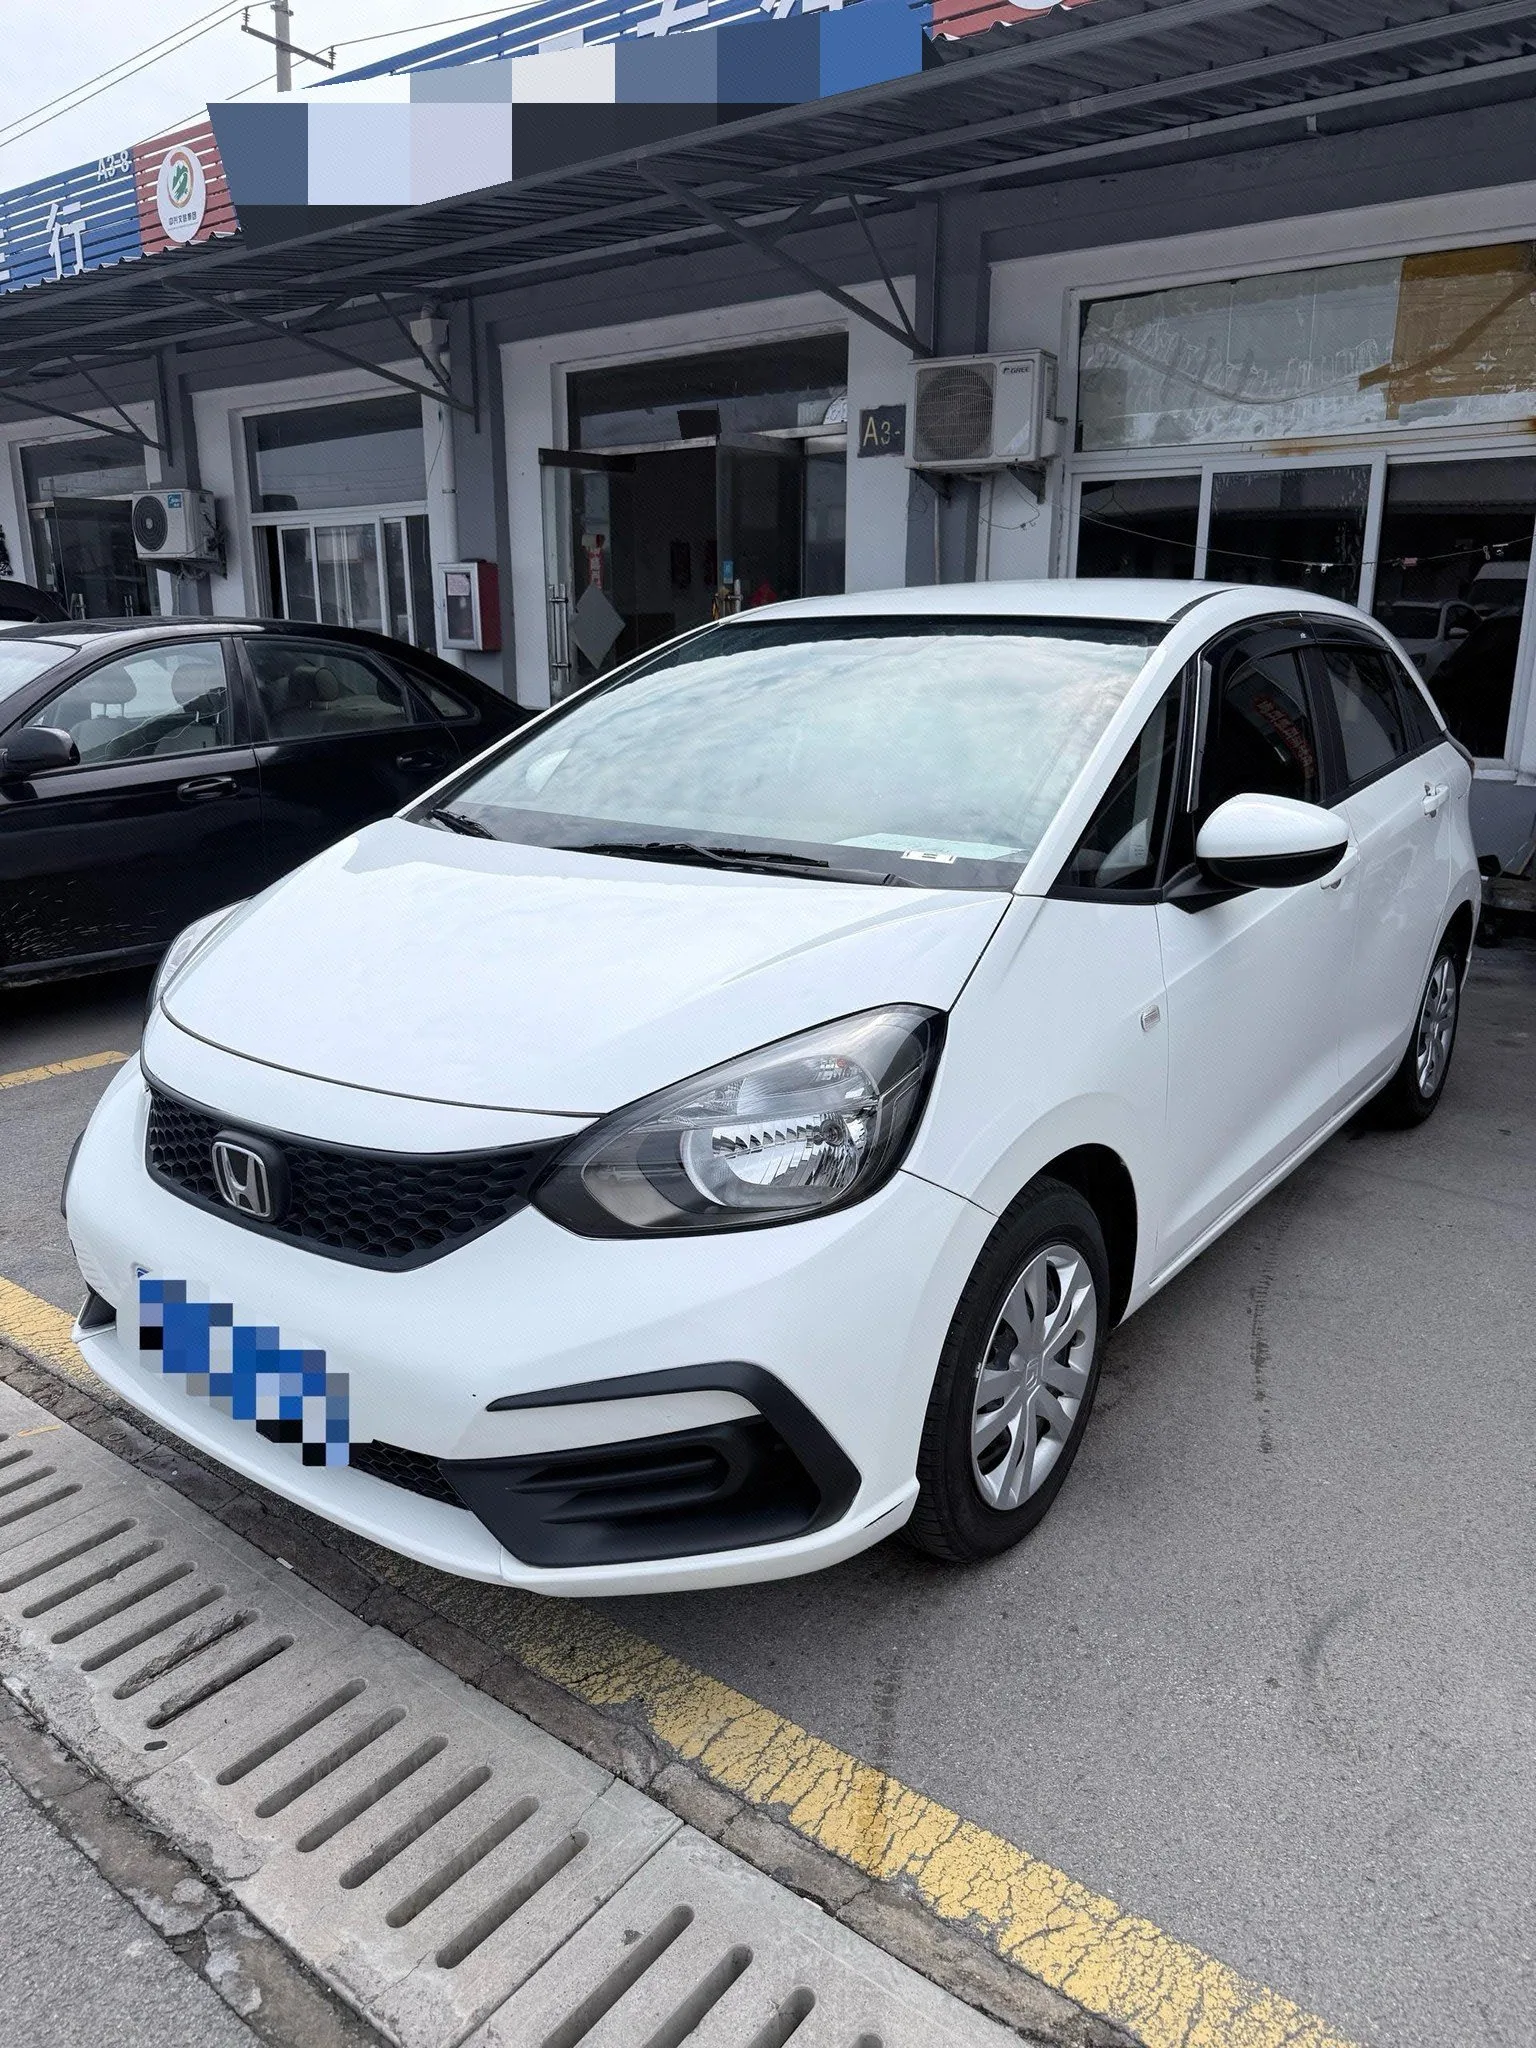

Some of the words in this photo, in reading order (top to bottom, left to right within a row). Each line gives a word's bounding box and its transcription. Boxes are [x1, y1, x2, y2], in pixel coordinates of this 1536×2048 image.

[97, 150, 130, 182] A3-8
[46, 202, 87, 279] 行
[1009, 366, 1030, 374] GREE
[863, 416, 901, 446] A3-
